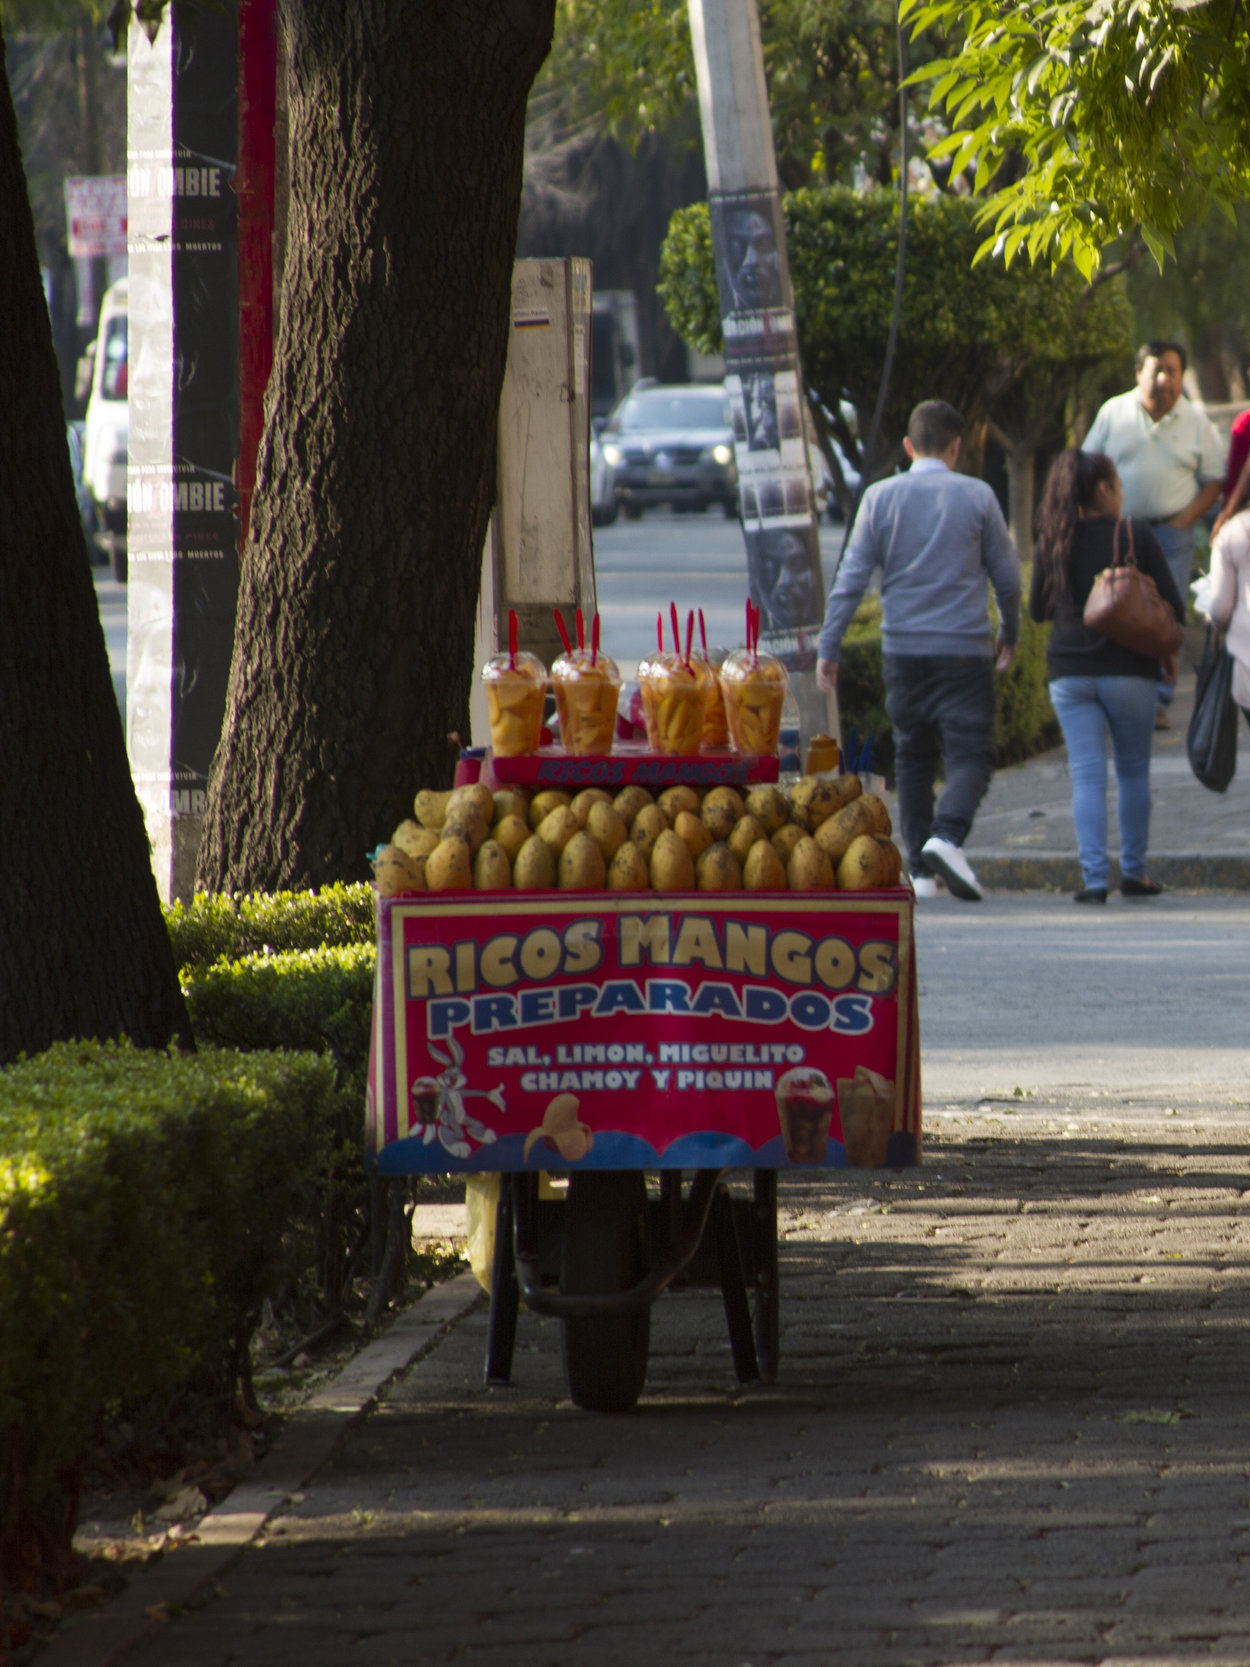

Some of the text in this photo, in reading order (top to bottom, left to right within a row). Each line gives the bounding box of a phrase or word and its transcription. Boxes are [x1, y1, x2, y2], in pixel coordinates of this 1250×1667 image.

[538, 760, 752, 783] RICOS MANGOS
[406, 912, 898, 999] RICOS MANGOS
[427, 978, 874, 1039] PREPARADOS
[487, 1043, 806, 1067] SAL, LIMON, MIGUELITO
[520, 1068, 775, 1091] CHAMOY Y PIQUIN
